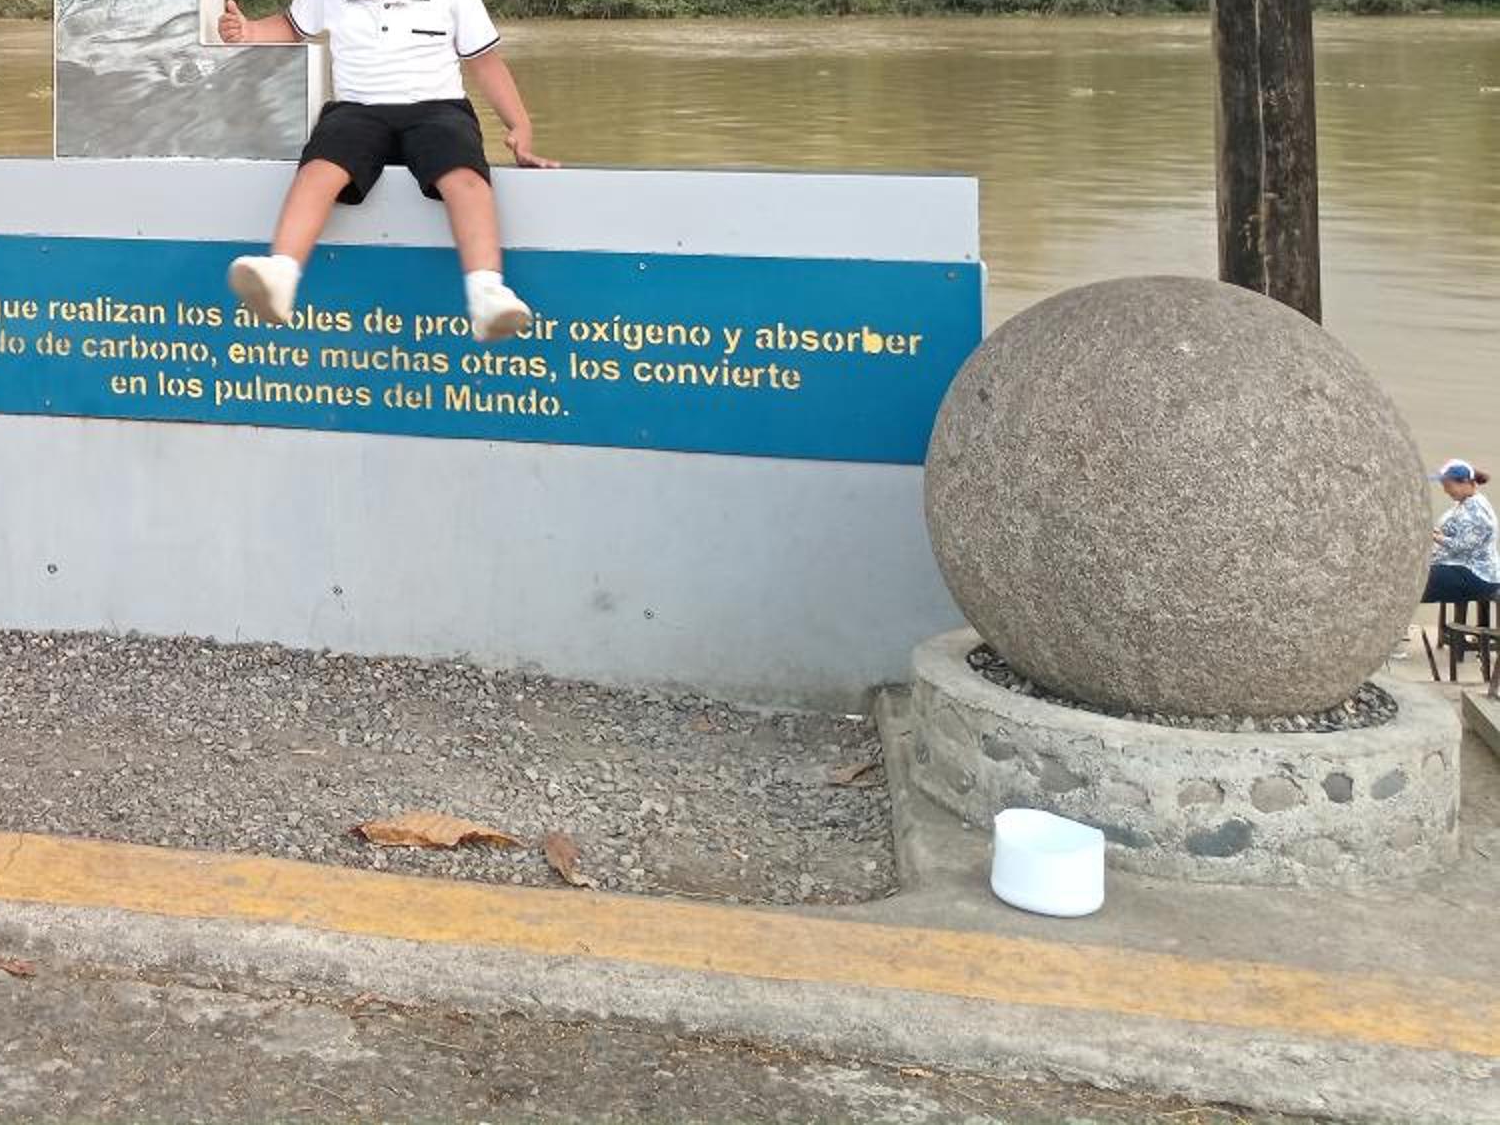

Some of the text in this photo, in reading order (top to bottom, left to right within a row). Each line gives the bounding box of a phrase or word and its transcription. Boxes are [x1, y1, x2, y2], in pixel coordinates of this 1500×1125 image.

[48, 295, 166, 325] realizan
[177, 302, 223, 328] los
[234, 302, 352, 332] ároles
[363, 306, 403, 335] de
[415, 312, 559, 343] procir
[569, 314, 711, 352] oxígeno
[723, 327, 744, 355] y
[755, 321, 923, 356] absorber
[35, 330, 72, 356] de
[81, 333, 218, 368] carbono,
[227, 340, 310, 368] entre
[320, 344, 450, 375] muchas
[460, 349, 557, 383] otras,
[569, 352, 621, 382] los
[633, 358, 801, 391] convierte
[110, 370, 569, 417] en los pulmones del Mundo.
